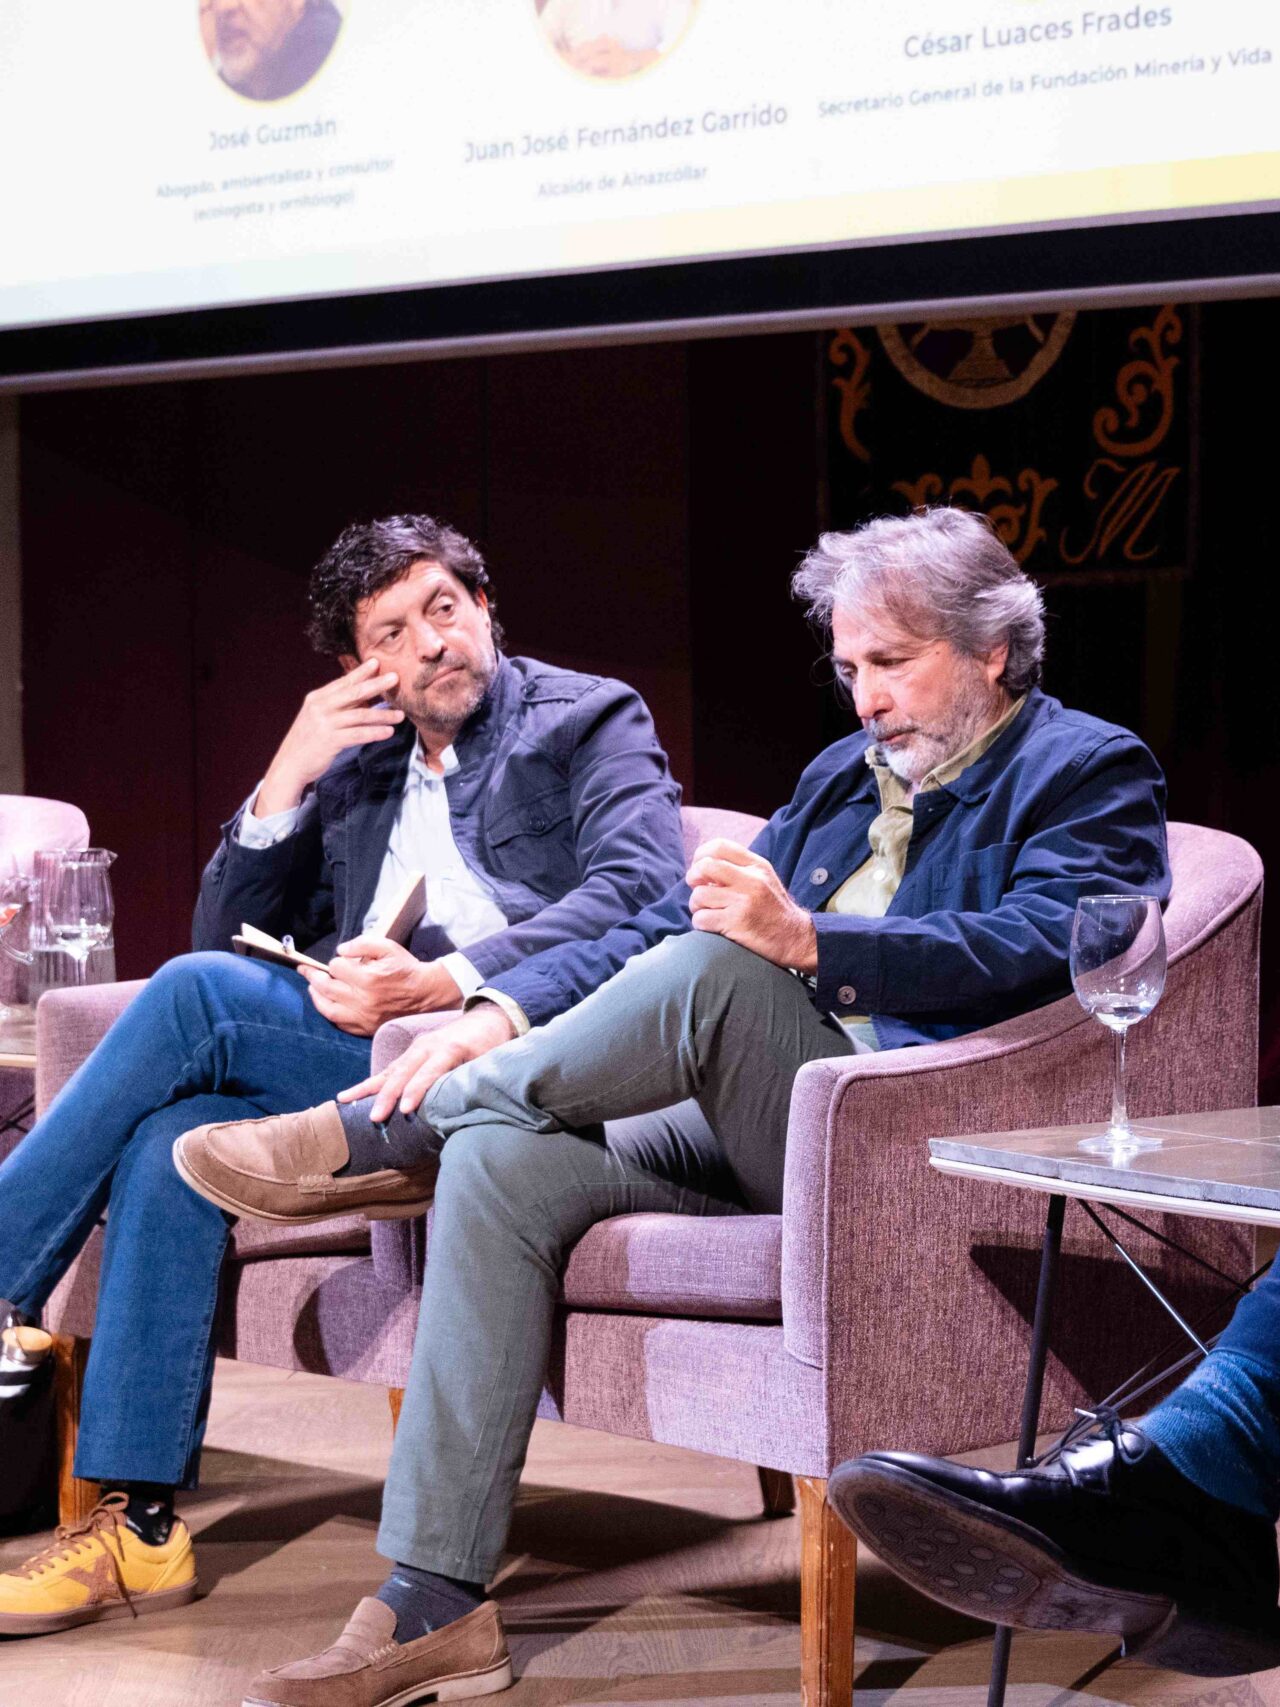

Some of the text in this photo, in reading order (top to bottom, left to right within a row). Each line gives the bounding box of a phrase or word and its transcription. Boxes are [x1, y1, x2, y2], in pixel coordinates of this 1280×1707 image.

[904, 4, 1172, 60] César Luaces Frades
[818, 47, 1272, 118] Secretario General de la Fundación Minería y Vida
[209, 116, 337, 151] José Guzmán
[463, 103, 788, 163] Juan José Fernández Garrido
[597, 174, 616, 191] de
